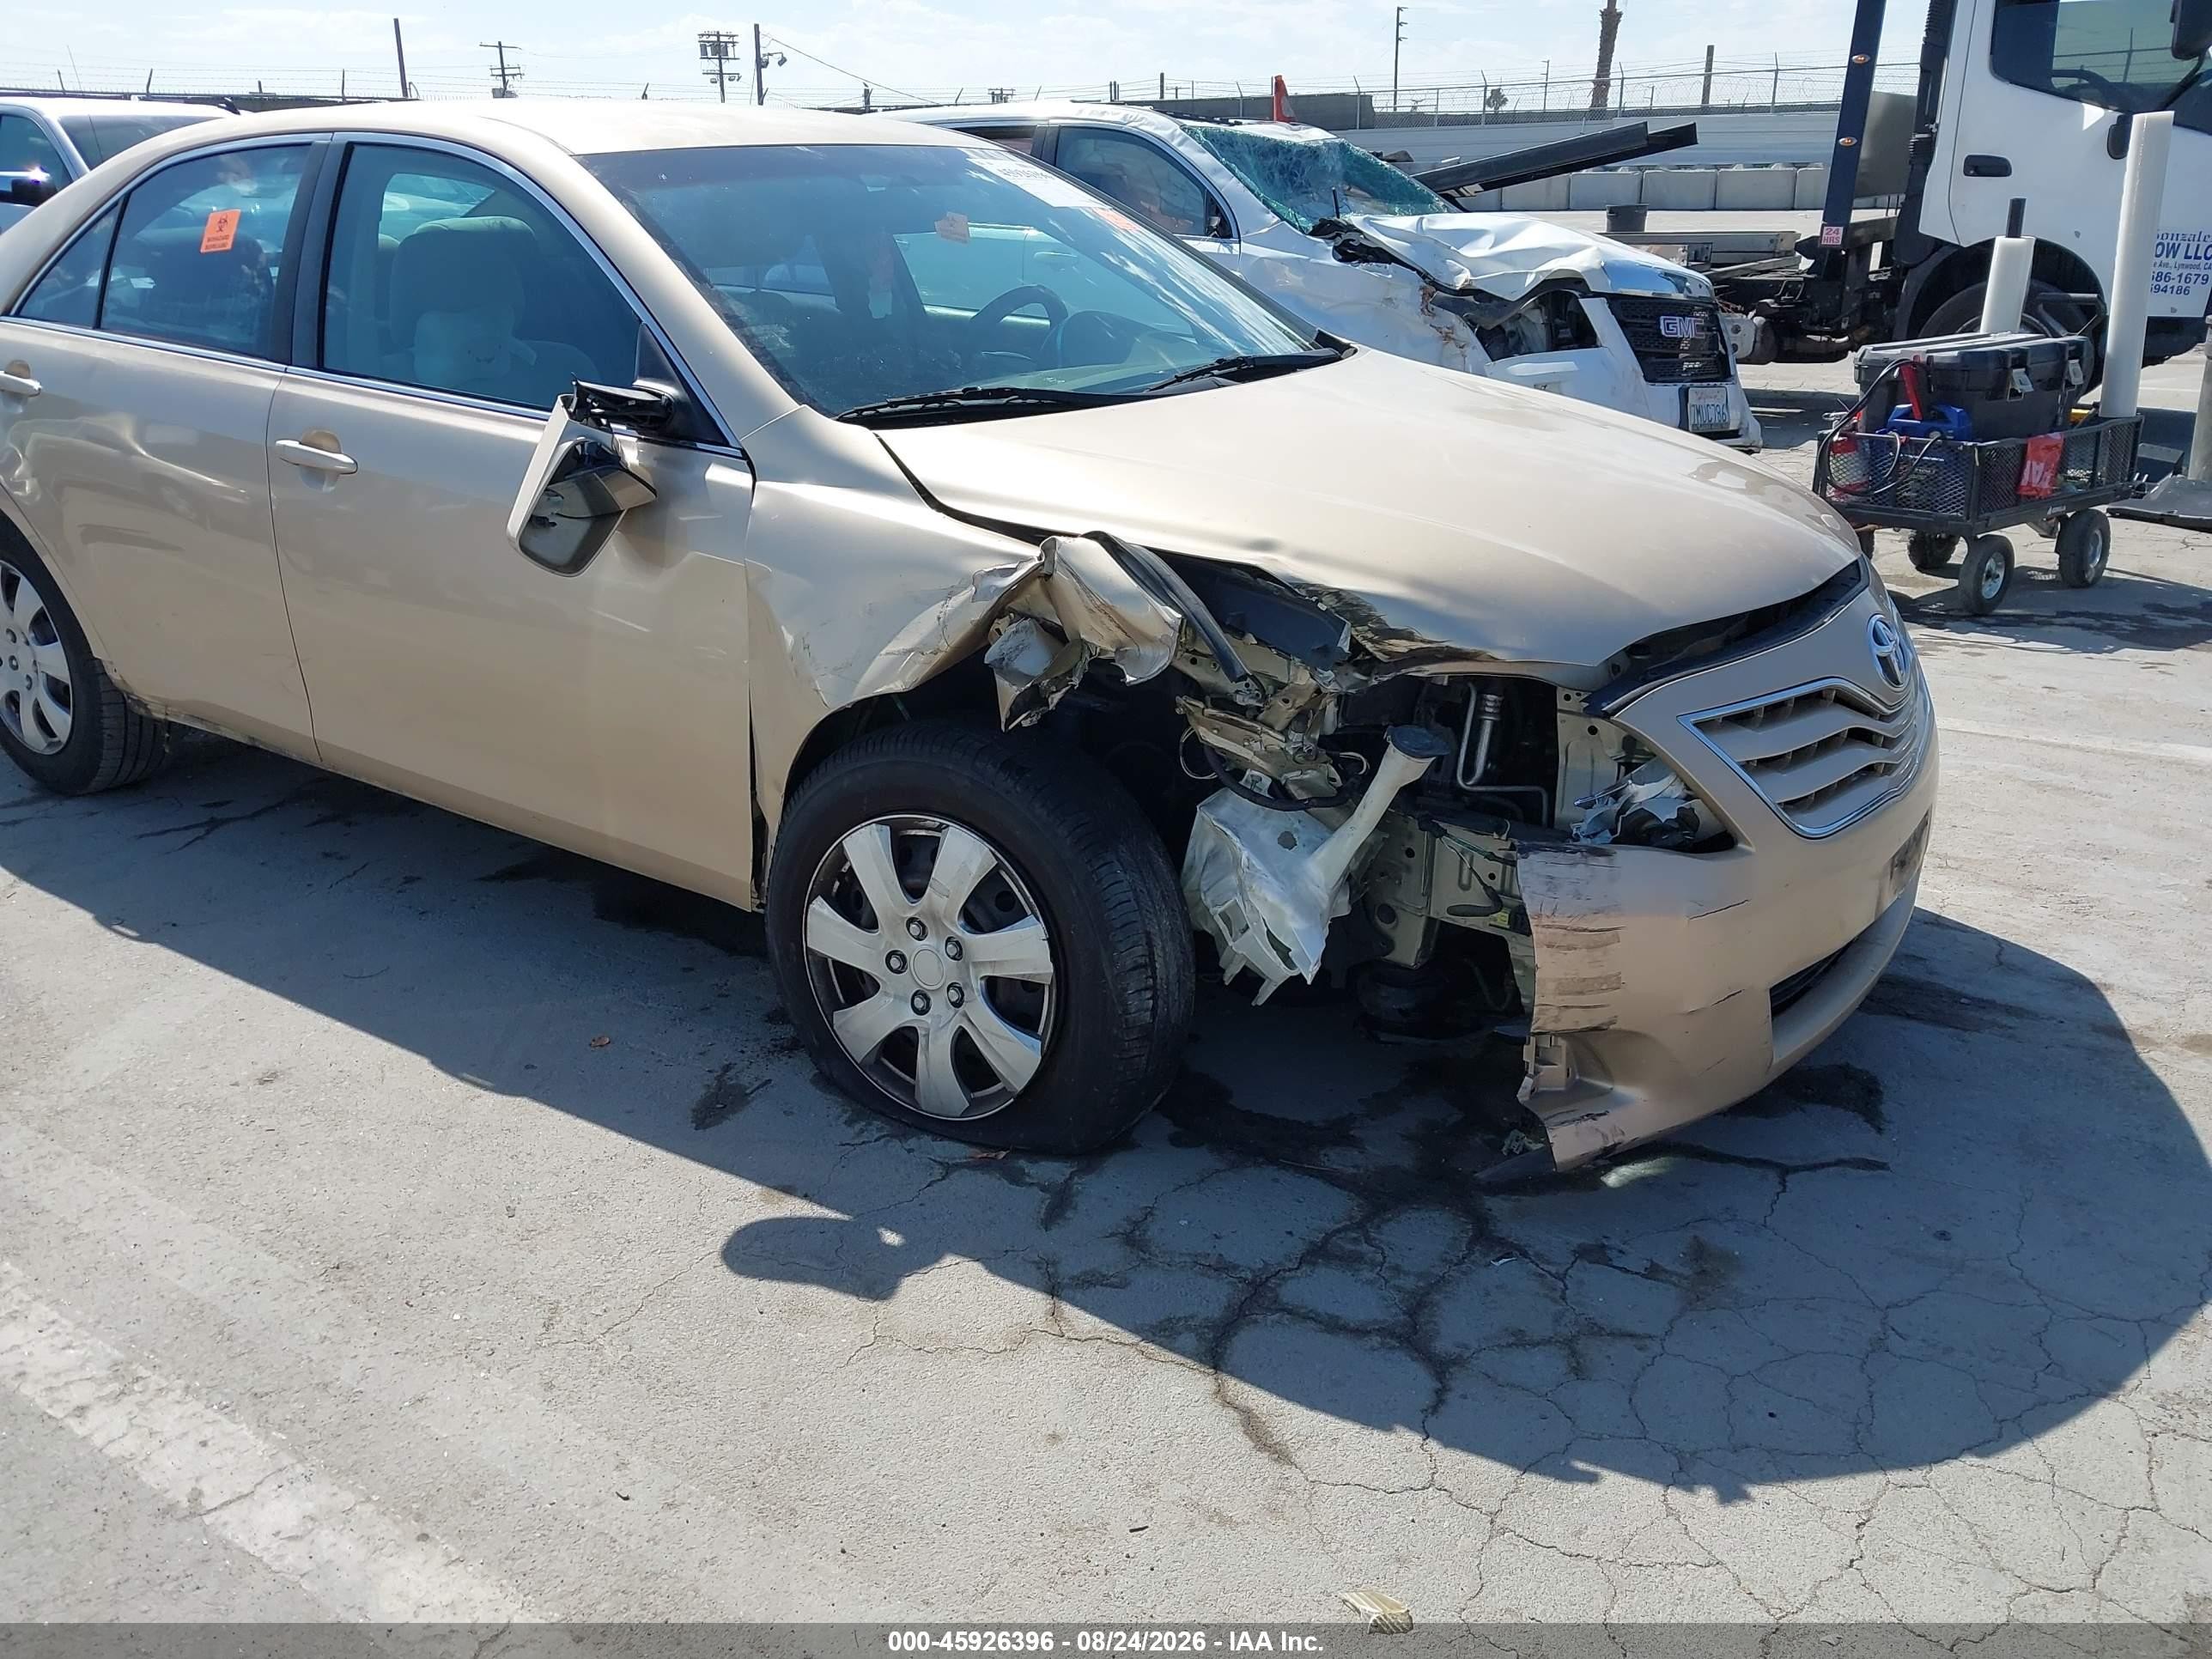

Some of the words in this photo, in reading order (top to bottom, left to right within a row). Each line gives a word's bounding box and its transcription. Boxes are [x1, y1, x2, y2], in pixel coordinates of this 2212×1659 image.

[2156, 231, 2212, 242] onzale
[2154, 241, 2181, 258] OW
[1660, 316, 1705, 338] GMC
